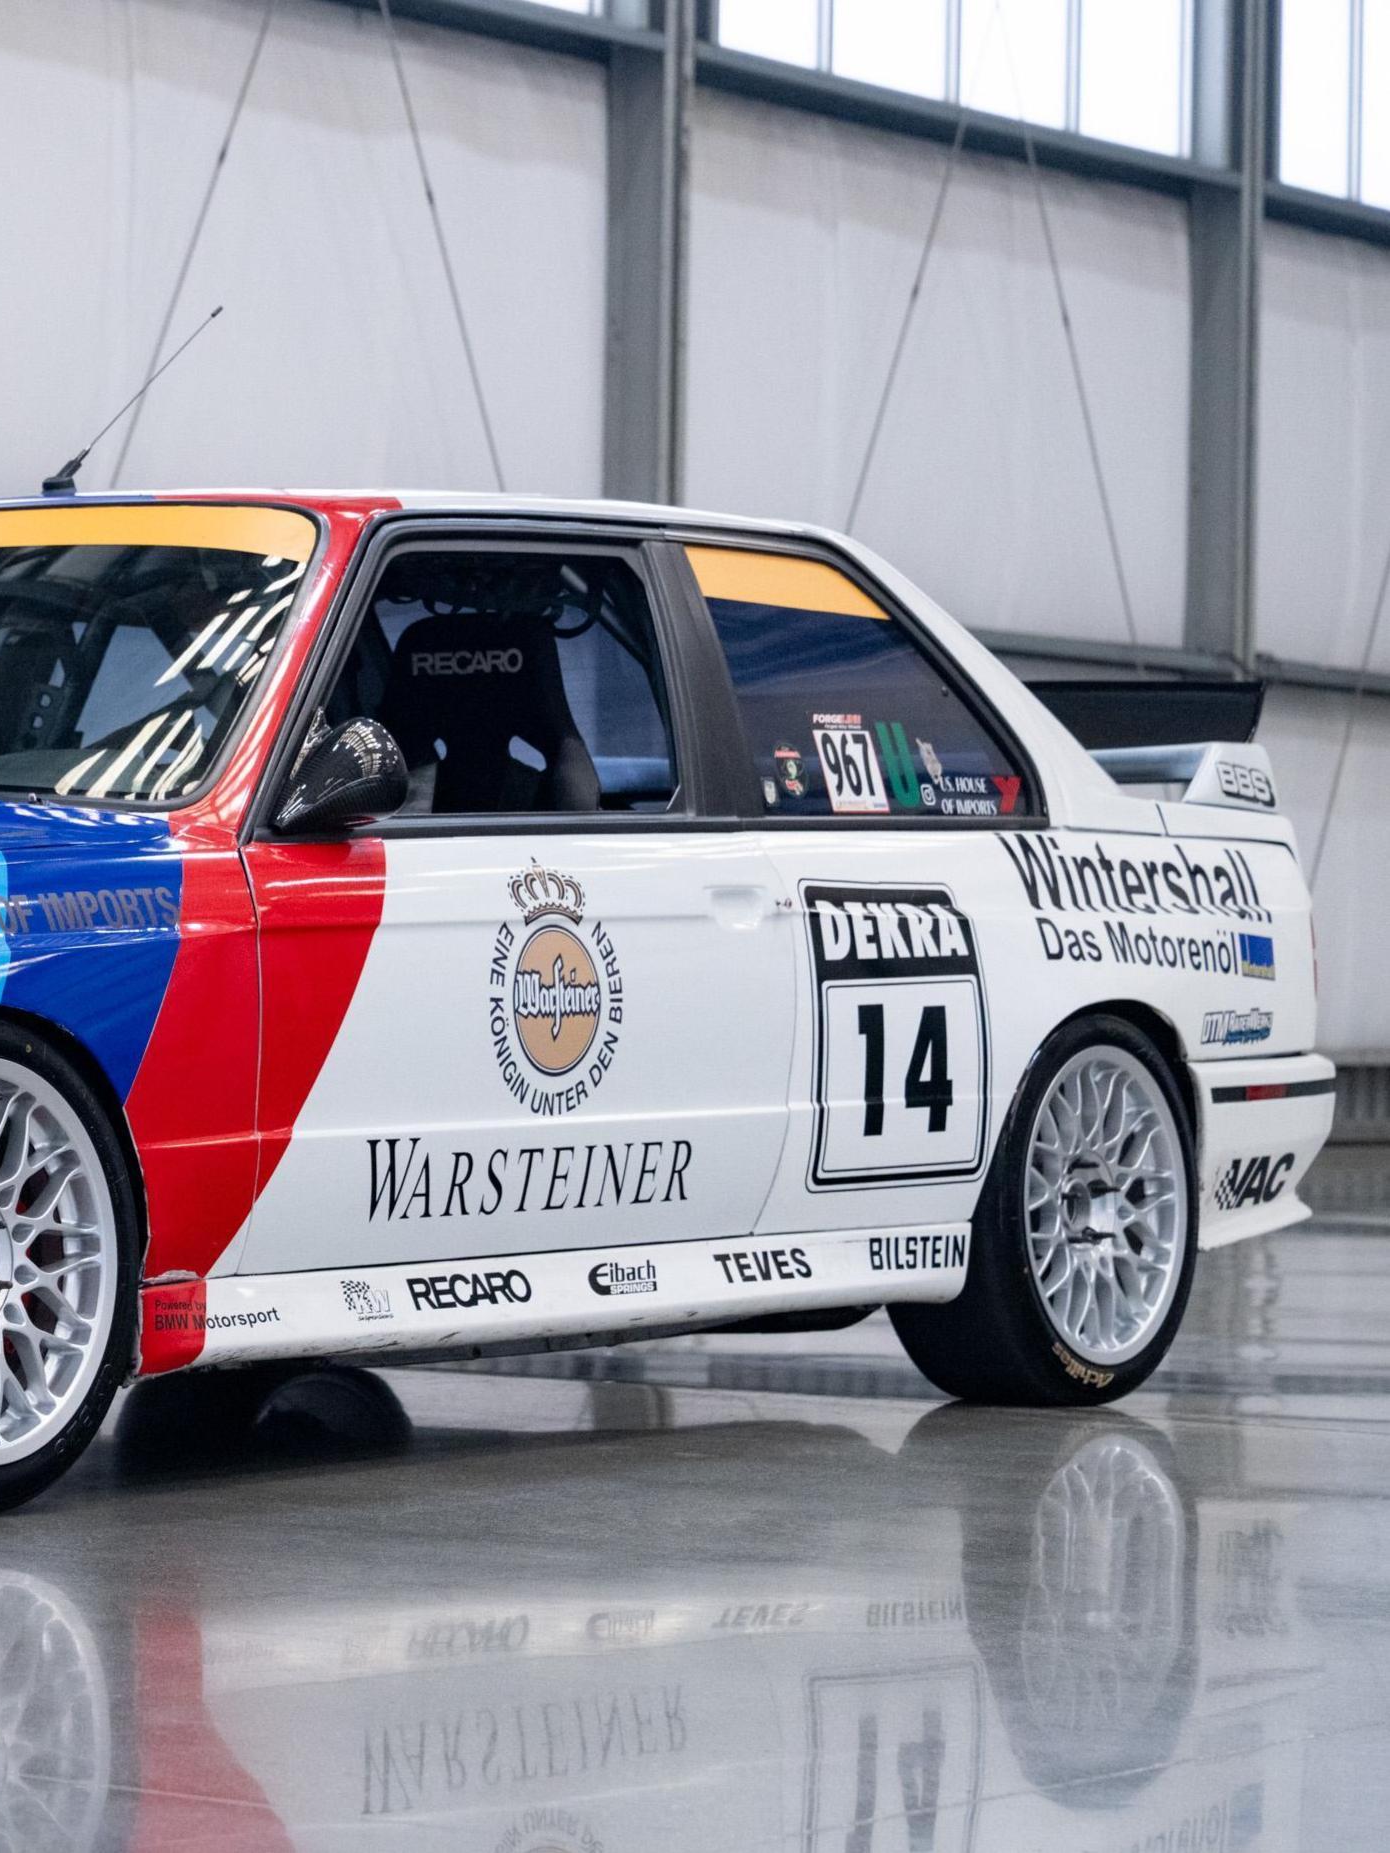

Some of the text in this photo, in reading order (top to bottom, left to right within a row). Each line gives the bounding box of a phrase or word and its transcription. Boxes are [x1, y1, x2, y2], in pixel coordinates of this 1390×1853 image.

[411, 647, 524, 677] RECARO
[821, 732, 876, 797] 967
[955, 776, 988, 794] HOUSE
[1215, 760, 1276, 808] BBS
[941, 798, 998, 816] OF IMPORTS
[994, 831, 1273, 924] Wintershall
[37, 886, 180, 932] IMPORTS
[814, 899, 970, 961] DEKRA
[1035, 916, 1103, 962] Das
[1103, 919, 1239, 976] Motorenöl
[488, 920, 624, 1117] EINE KÖNIGIN UNTER DEN BIEREN
[857, 1003, 953, 1138] 14
[366, 1137, 693, 1223] WARSTEINER
[1228, 1152, 1296, 1209] VAC
[712, 1248, 813, 1284] TEVES
[868, 1235, 966, 1271] BILSTEIN
[405, 1269, 532, 1311] RECARO
[587, 1259, 658, 1296] Eibach
[610, 1281, 656, 1295] SPRINGS
[154, 1307, 281, 1331] BMW Motorsport
